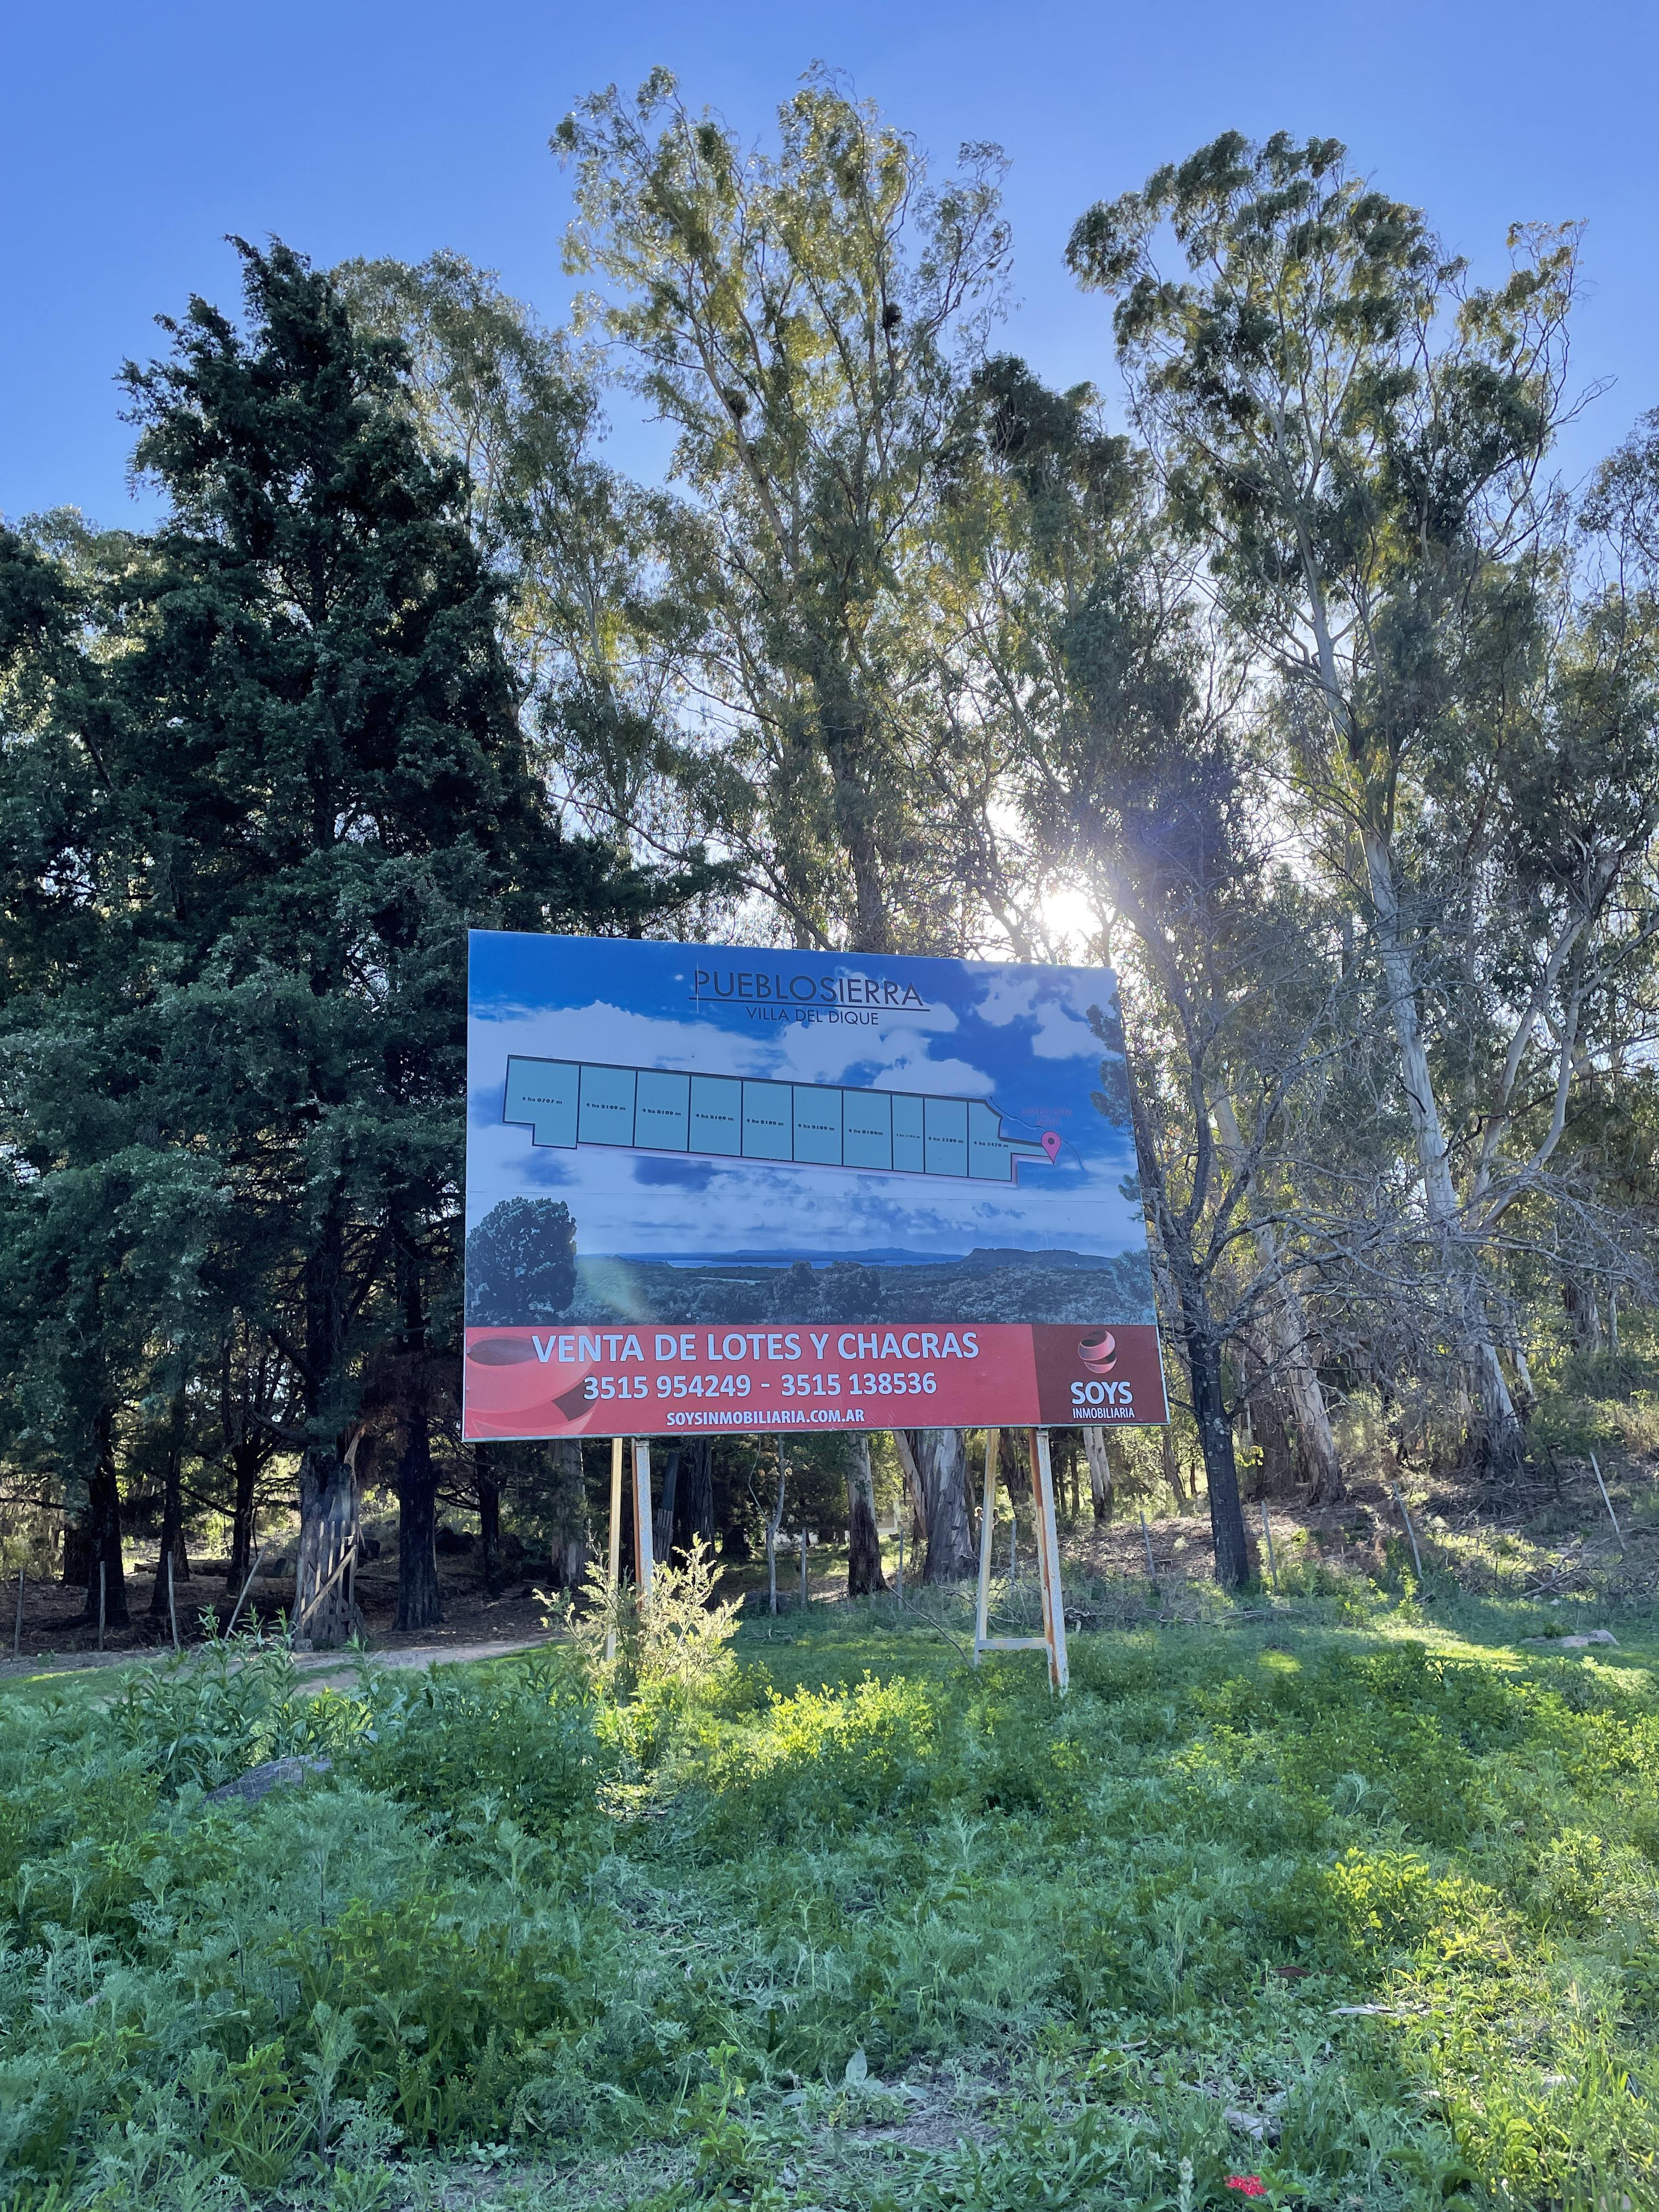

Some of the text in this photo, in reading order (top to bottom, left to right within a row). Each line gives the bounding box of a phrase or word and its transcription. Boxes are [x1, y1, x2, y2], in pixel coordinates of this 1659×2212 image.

[695, 970, 923, 1006] PUEBLOSIERRA
[746, 1006, 878, 1025] VILLA DEL DIQUE
[532, 1331, 980, 1363] VENTA DE LOTES Y CHACRAS
[583, 1376, 649, 1400] 3515
[657, 1374, 752, 1398] 954249
[781, 1373, 842, 1396] 3515
[848, 1372, 938, 1396] 138536
[1070, 1381, 1133, 1405] SOYS
[666, 1408, 866, 1426] SOYSINMOBILIARIA.COM.AR
[1072, 1407, 1136, 1419] INMOBILIARIA
